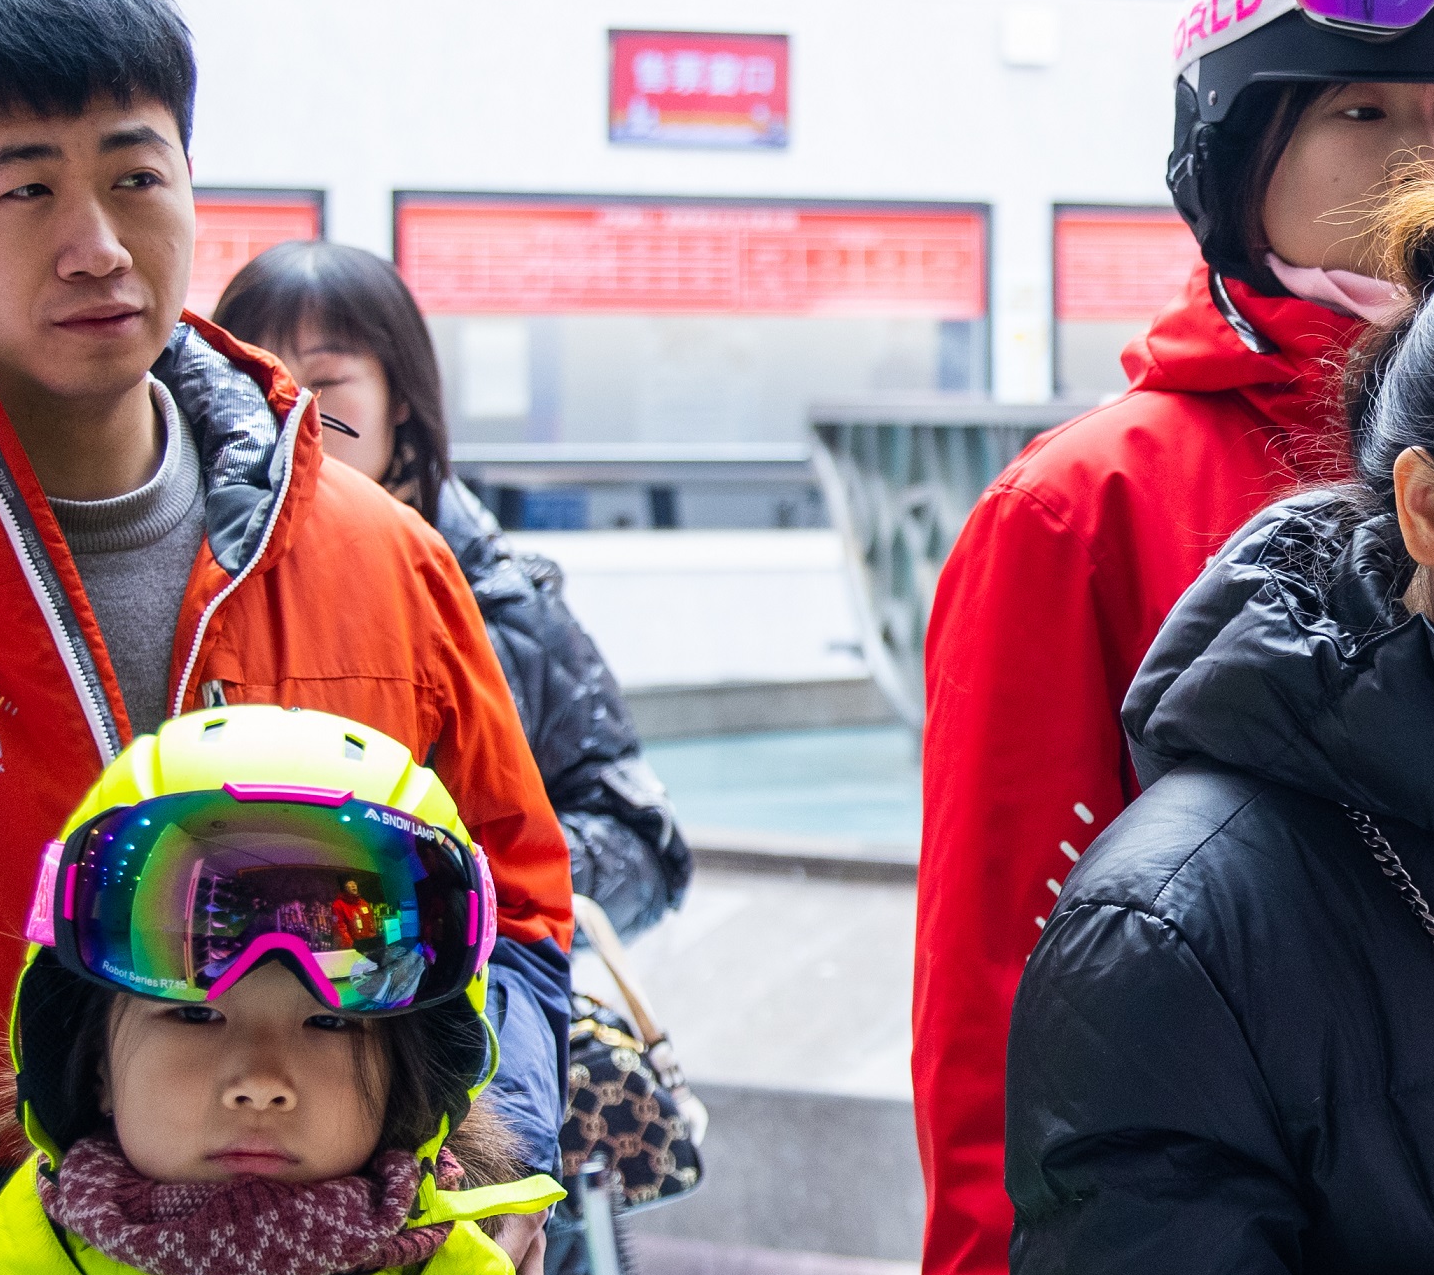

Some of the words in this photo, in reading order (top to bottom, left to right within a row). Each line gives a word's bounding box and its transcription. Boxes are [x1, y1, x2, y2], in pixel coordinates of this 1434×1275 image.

[22, 527, 42, 560] RIVER
[34, 555, 66, 607] RUNNING
[381, 811, 412, 833] SNOW
[412, 822, 436, 843] LAMP
[102, 960, 128, 979] Robot
[129, 971, 159, 988] Series
